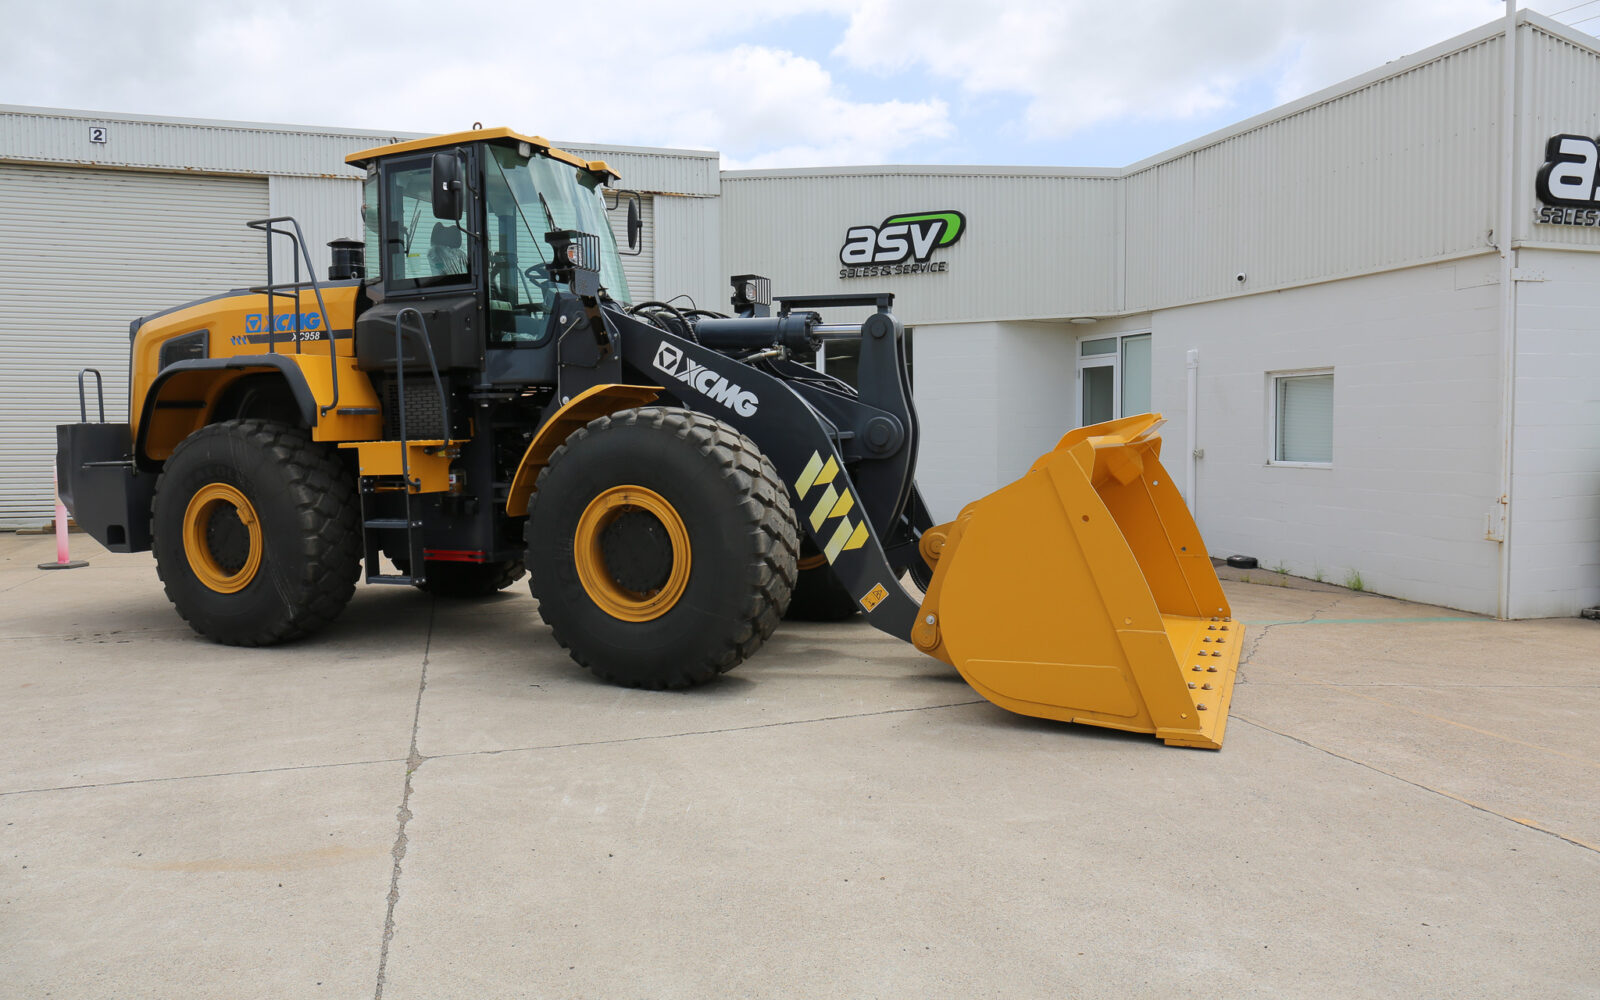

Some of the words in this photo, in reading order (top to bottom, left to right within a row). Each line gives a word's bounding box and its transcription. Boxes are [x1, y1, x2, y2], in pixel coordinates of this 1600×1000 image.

[93, 129, 103, 141] 2
[880, 264, 892, 276] &
[894, 261, 947, 275] SERVICE
[263, 312, 320, 332] XCMG
[674, 357, 759, 418] XCMG
